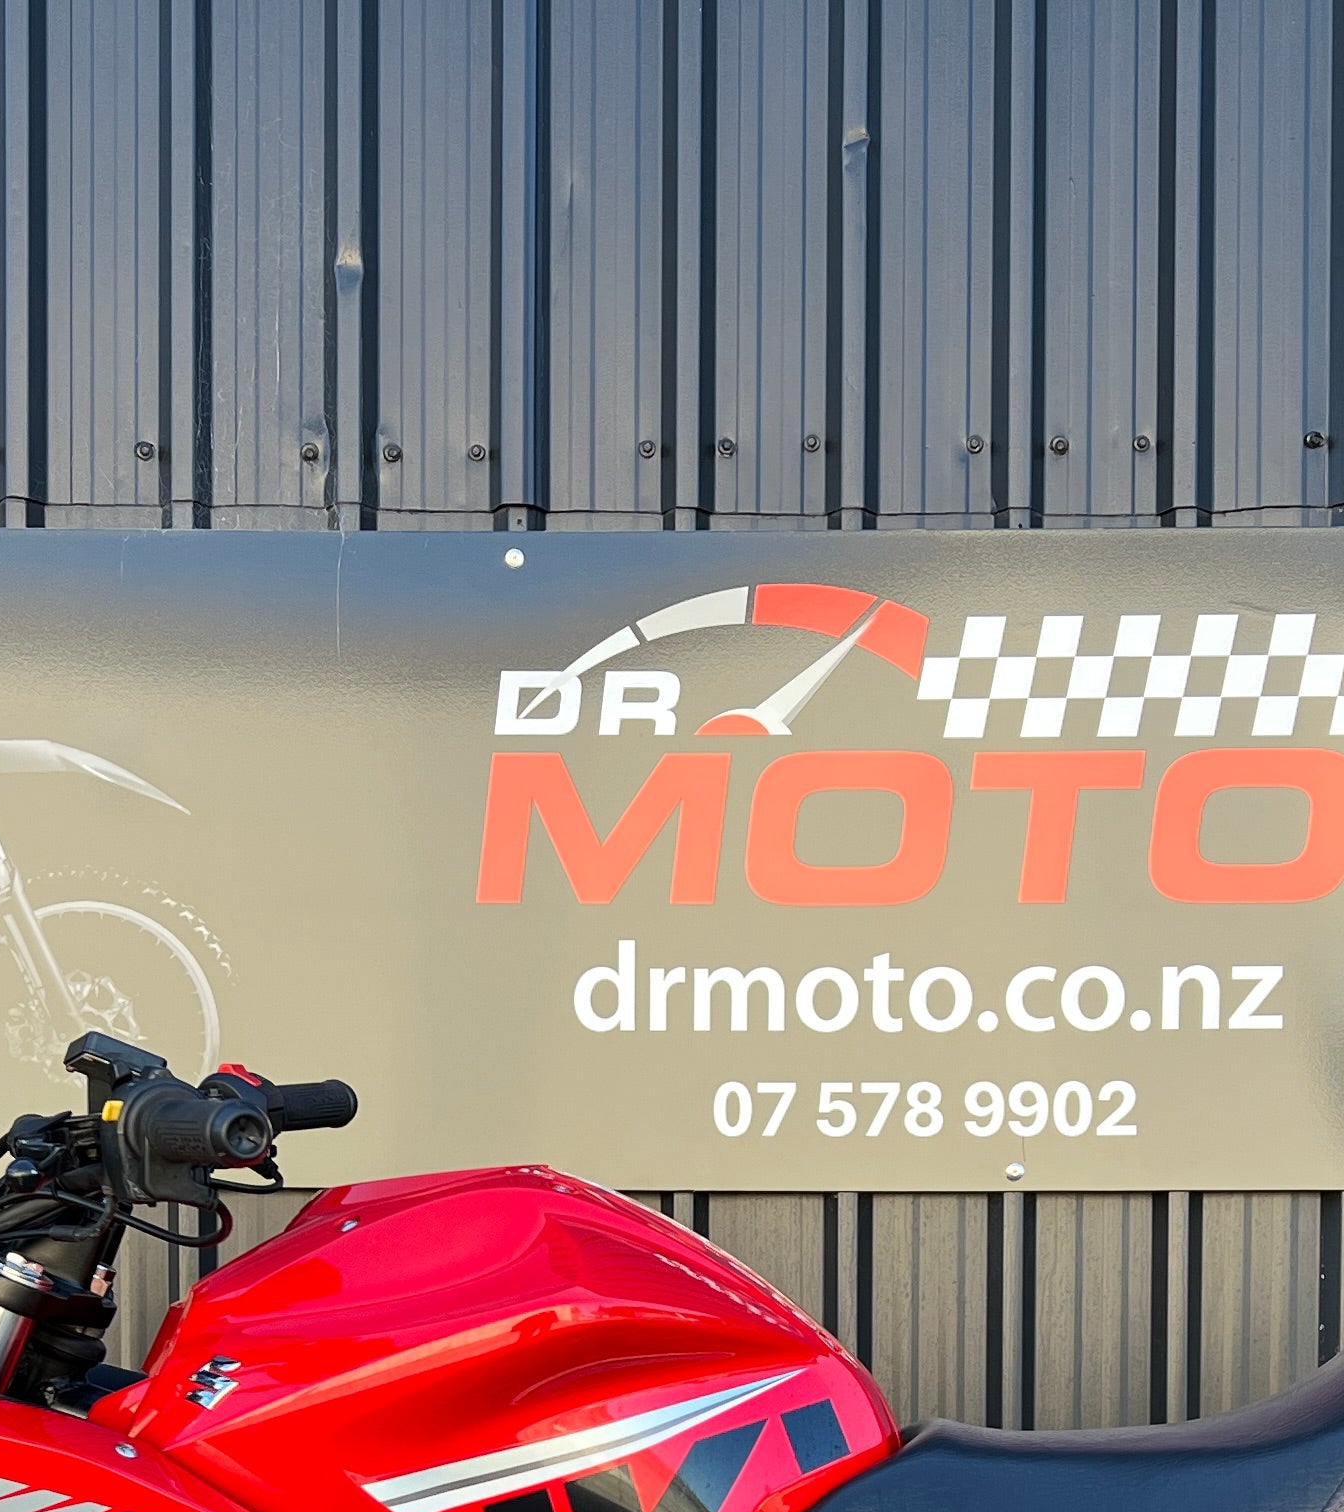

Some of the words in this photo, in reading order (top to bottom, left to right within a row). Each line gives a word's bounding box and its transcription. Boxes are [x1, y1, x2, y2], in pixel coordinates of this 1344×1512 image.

[494, 669, 681, 736] DR
[572, 939, 1285, 1034] drmoto.co.nz
[712, 1080, 797, 1138] 07
[815, 1080, 944, 1138] 578
[964, 1080, 1138, 1138] 9902
